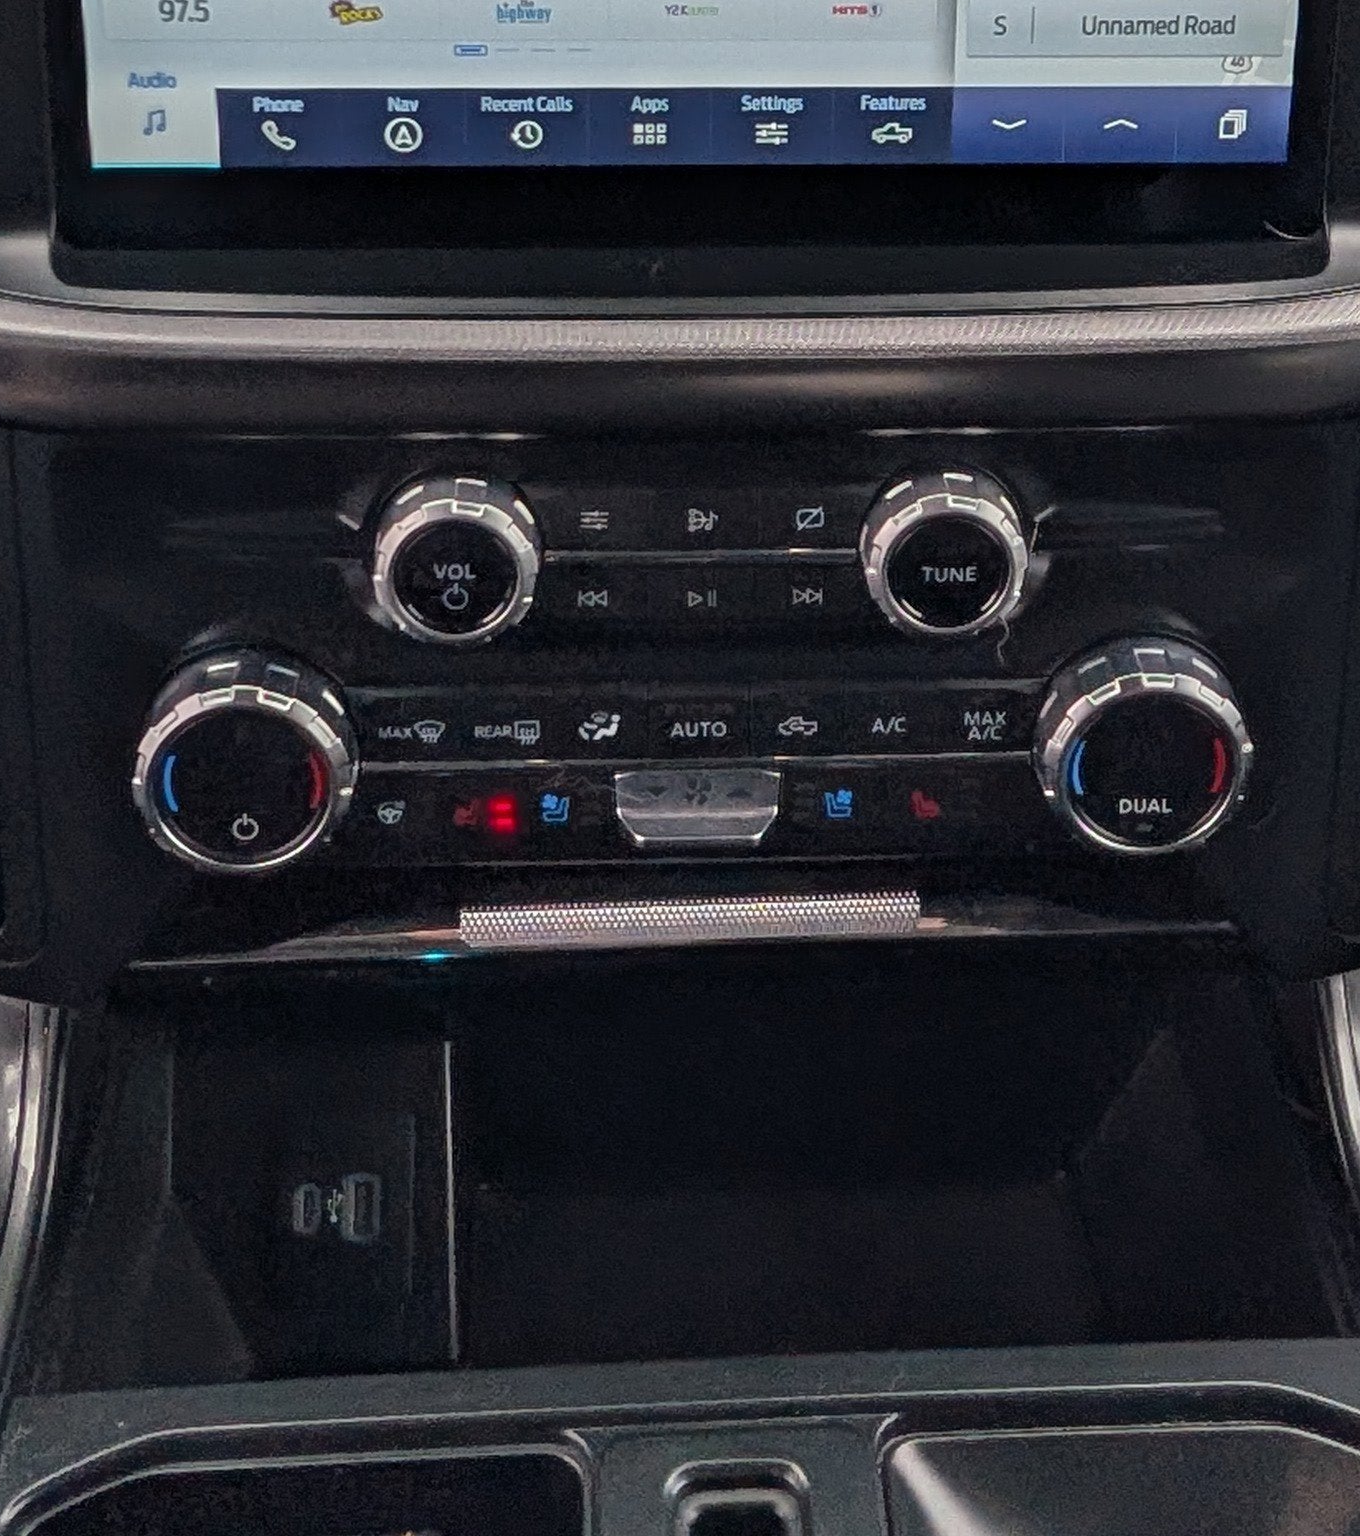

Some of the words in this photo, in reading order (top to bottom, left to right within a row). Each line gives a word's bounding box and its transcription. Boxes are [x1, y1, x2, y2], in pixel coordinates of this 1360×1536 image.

[496, 2, 552, 24] highway
[992, 15, 1008, 37] S
[1081, 15, 1181, 38] Unnamed
[1184, 15, 1237, 38] Road
[127, 72, 178, 90] Audio
[252, 96, 305, 114] Phone
[386, 96, 420, 114] Nav
[480, 96, 534, 114] Recent
[536, 96, 574, 114] Calls
[630, 96, 670, 117] Apps
[740, 95, 805, 116] Settings
[859, 95, 927, 113] Features
[432, 562, 477, 581] VOL
[921, 566, 978, 583] TUNE
[871, 716, 907, 734] A/C
[963, 710, 1007, 726] MAX
[378, 724, 413, 740] MAX
[474, 723, 513, 740] REAR
[670, 720, 727, 739] AUTO
[967, 725, 1003, 741] A/C
[1118, 798, 1173, 815] DUAL
